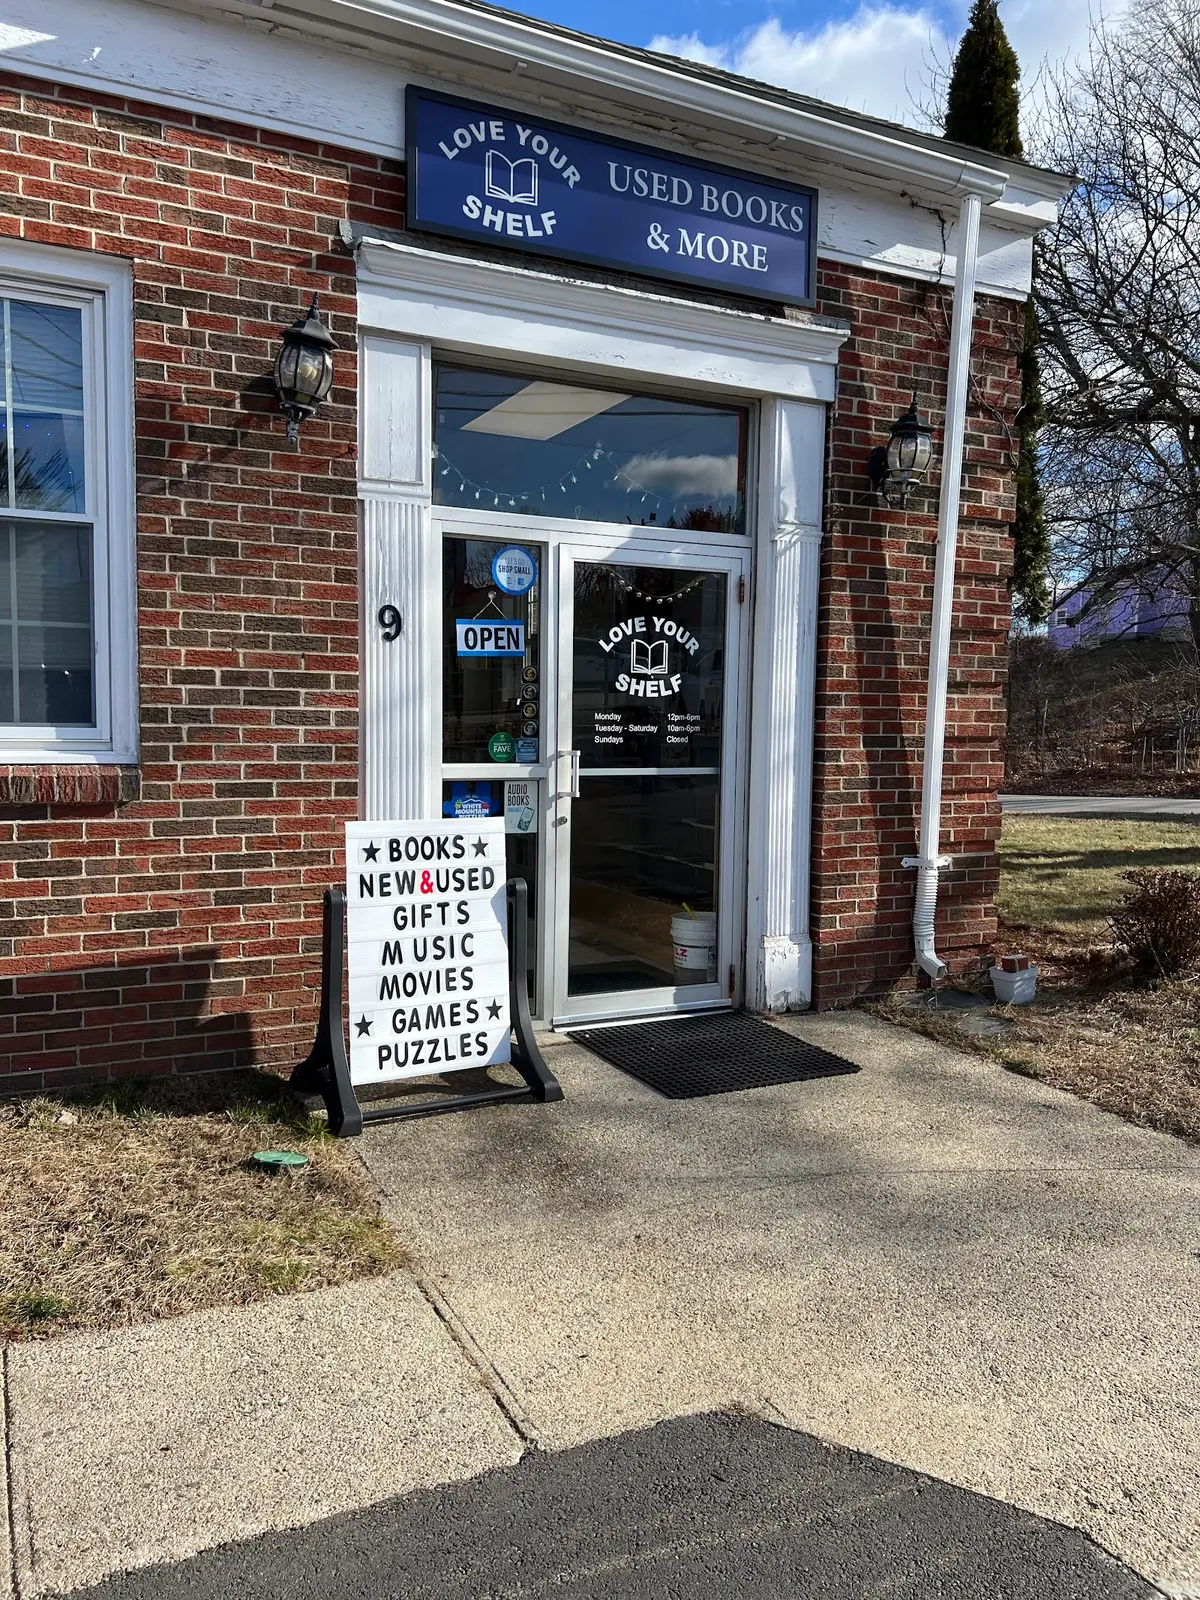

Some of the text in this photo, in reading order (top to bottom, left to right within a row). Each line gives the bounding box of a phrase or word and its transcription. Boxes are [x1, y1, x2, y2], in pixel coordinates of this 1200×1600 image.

[438, 120, 582, 189] LOVE YOUR
[606, 160, 804, 233] USED BOOKS
[462, 194, 558, 238] SHELF
[646, 222, 769, 273] & MORE
[498, 564, 531, 575] SHOP SMALL
[378, 604, 402, 642] 9
[464, 627, 520, 650] OPEN
[598, 616, 700, 656] LOVE YOUR
[615, 673, 683, 698] SHELF
[594, 712, 701, 721] Monday 12pm-6pm
[594, 724, 623, 733] Tuesday
[628, 724, 659, 733] Saturday
[667, 724, 701, 733] 10am-6pm
[493, 745, 512, 753] FAVE
[594, 735, 689, 744] Sundays Closed
[507, 784, 528, 795] AUDIO
[507, 795, 530, 806] BOOKS
[389, 834, 466, 863] BOOKS
[393, 900, 470, 931] GIFTS
[381, 932, 475, 967] MUSIC
[379, 966, 474, 1001] MOVIES
[392, 999, 480, 1034] GAMES
[378, 1031, 489, 1071] PUZZLES
